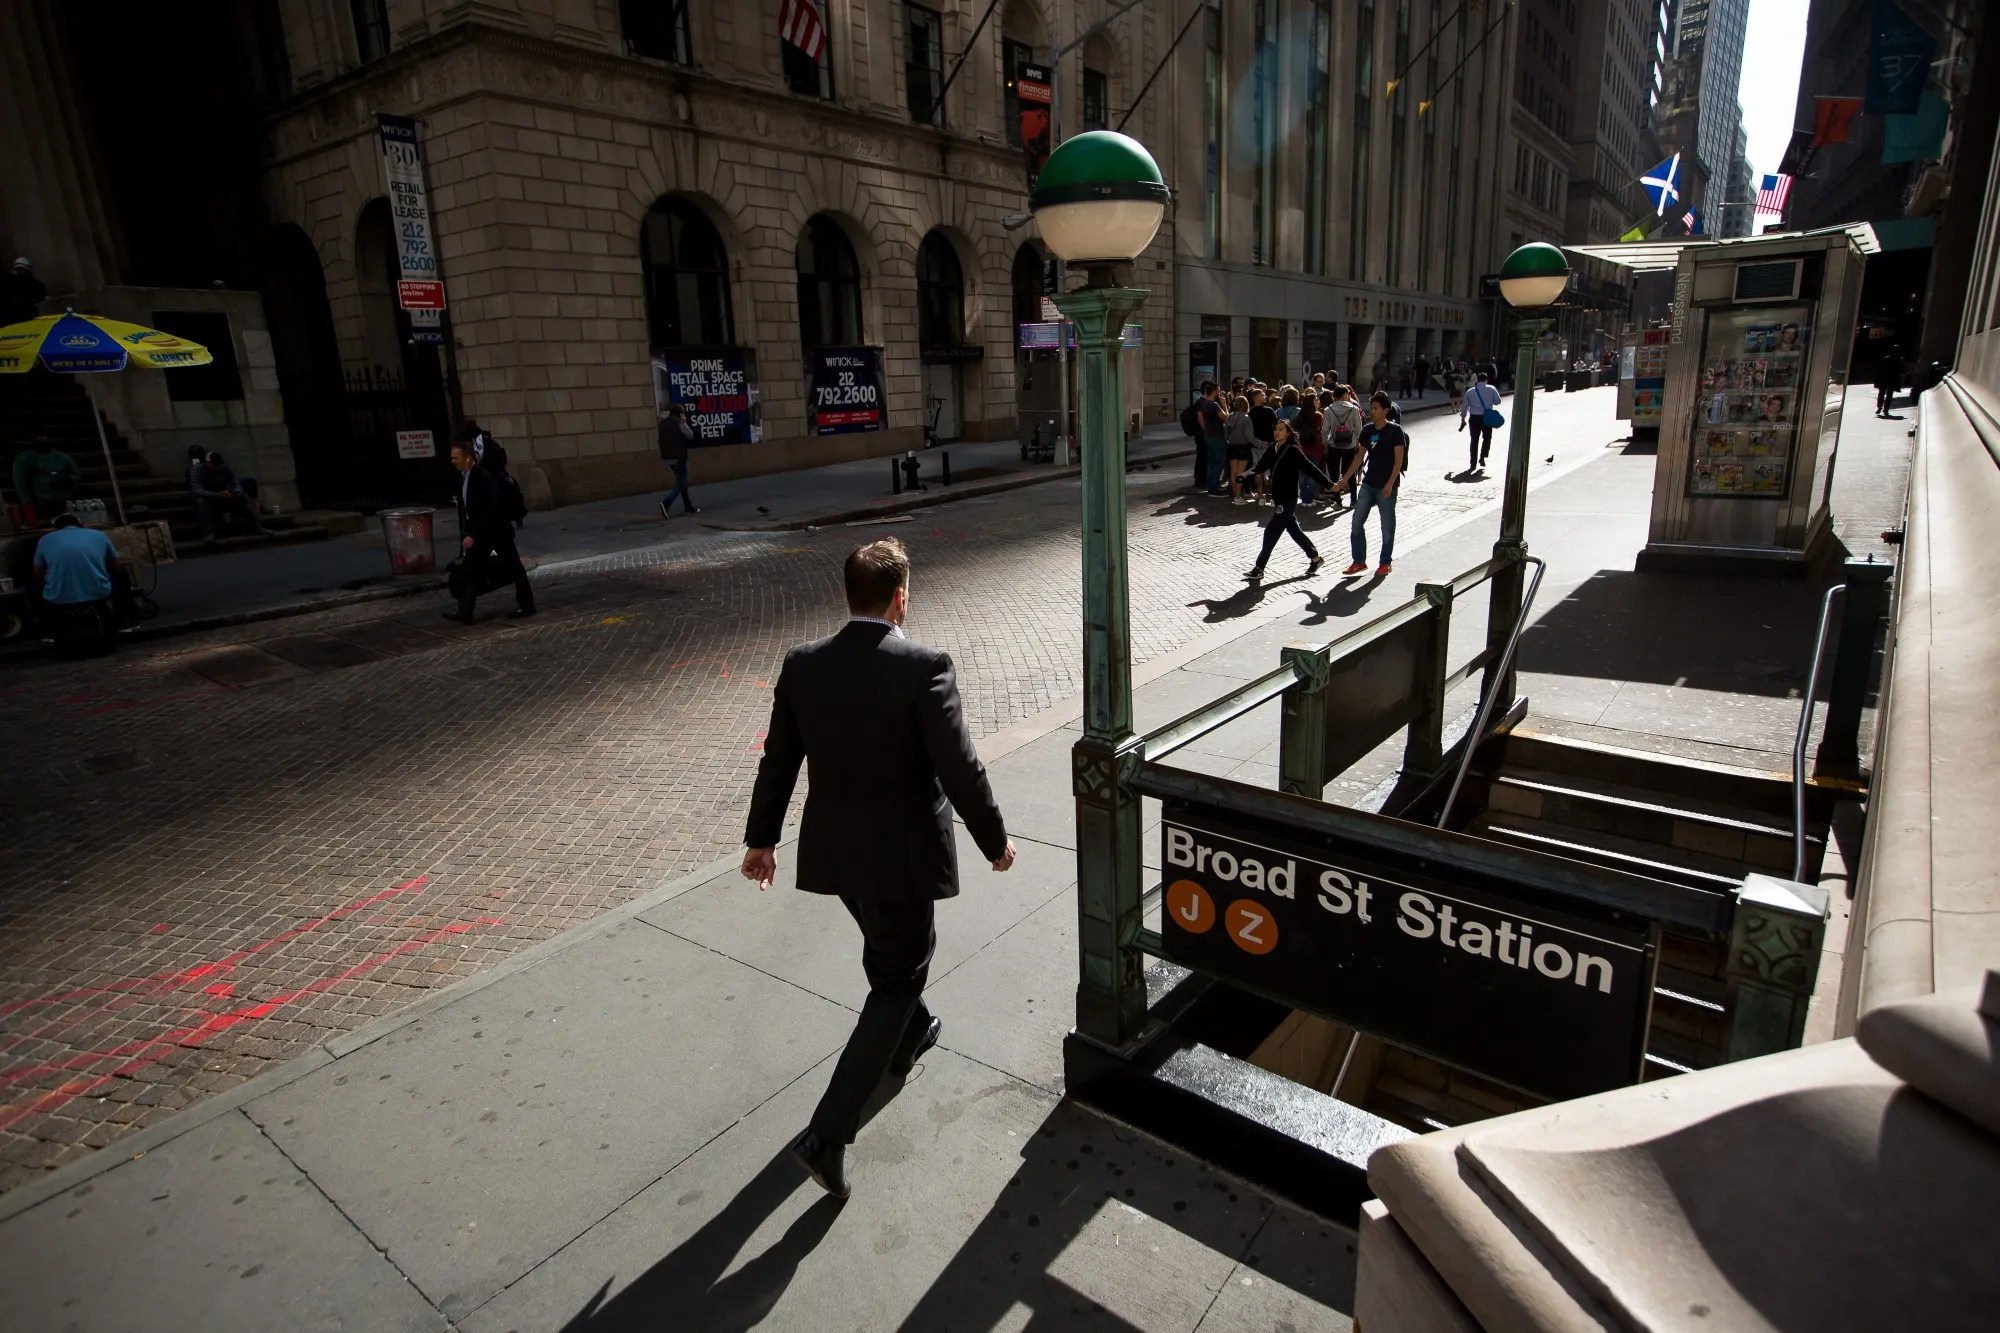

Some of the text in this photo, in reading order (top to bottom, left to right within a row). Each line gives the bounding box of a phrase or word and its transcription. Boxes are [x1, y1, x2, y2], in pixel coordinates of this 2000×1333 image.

[1025, 68, 1043, 79] NYC
[1019, 81, 1050, 96] financial
[389, 145, 414, 166] 30
[390, 181, 424, 195] RETAIL
[398, 195, 419, 206] FOR
[394, 206, 427, 219] LEASE
[401, 222, 425, 238] 212
[403, 239, 429, 255] 792
[401, 255, 435, 271] 2600
[1344, 296, 1464, 325] THE TRUMP BUILDING
[1671, 272, 1692, 345] Newsstand
[690, 359, 724, 372] PRIME
[670, 370, 744, 385] RETAIL SPACE
[838, 371, 855, 386] 212
[680, 383, 738, 397] FOR LEASE
[816, 385, 877, 406] 792.2600
[684, 403, 696, 411] TO
[690, 412, 734, 427] SQUARE
[701, 425, 726, 438] FEET
[1166, 826, 1615, 995] Broad St Station
[1179, 894, 1265, 945] J Z
